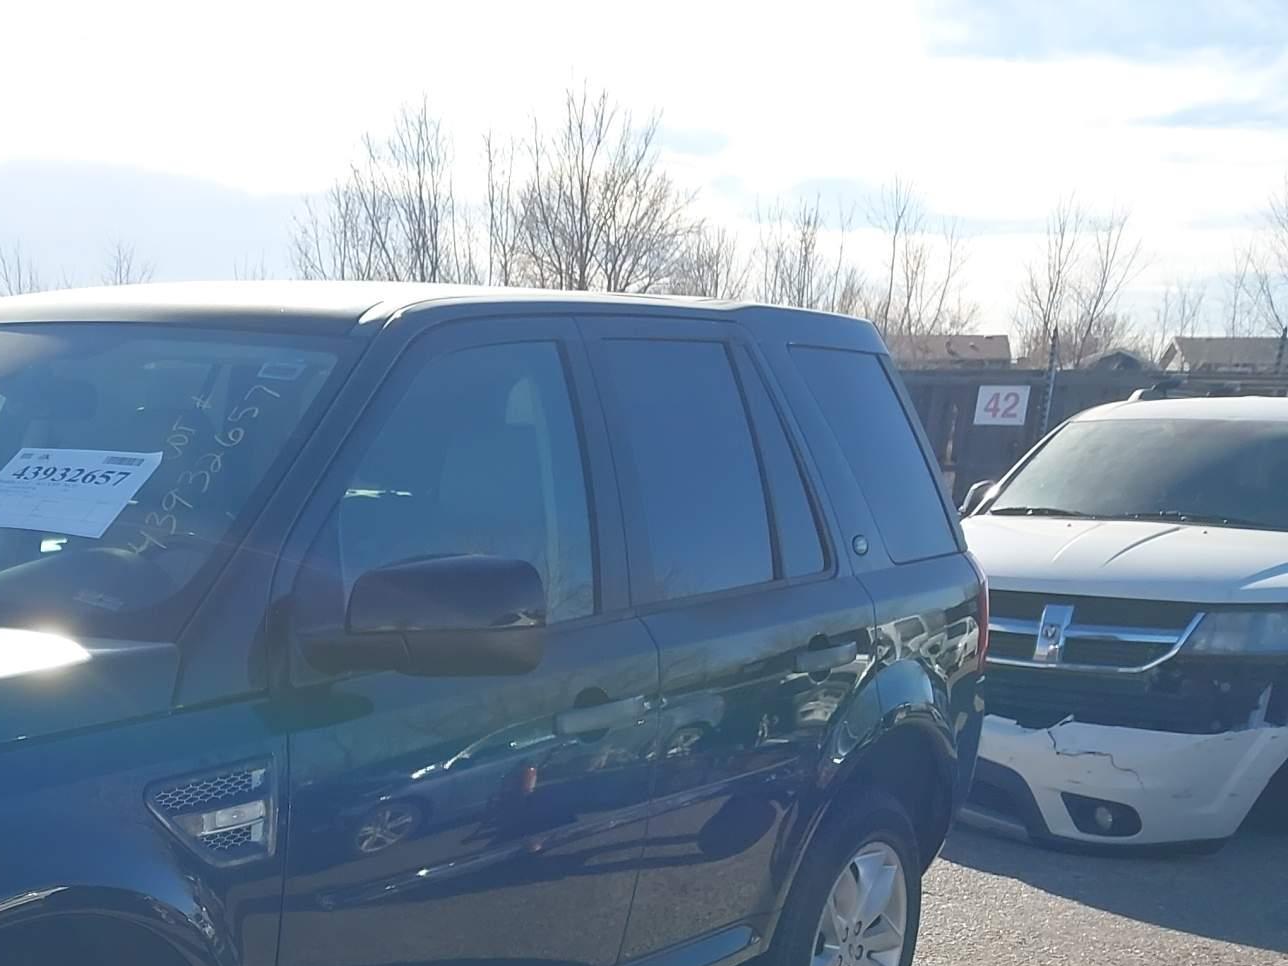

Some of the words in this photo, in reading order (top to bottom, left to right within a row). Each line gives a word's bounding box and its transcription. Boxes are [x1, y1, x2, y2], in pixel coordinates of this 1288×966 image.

[983, 391, 1021, 419] 42
[12, 464, 132, 487] 43932657
[127, 384, 281, 555] 43932657
